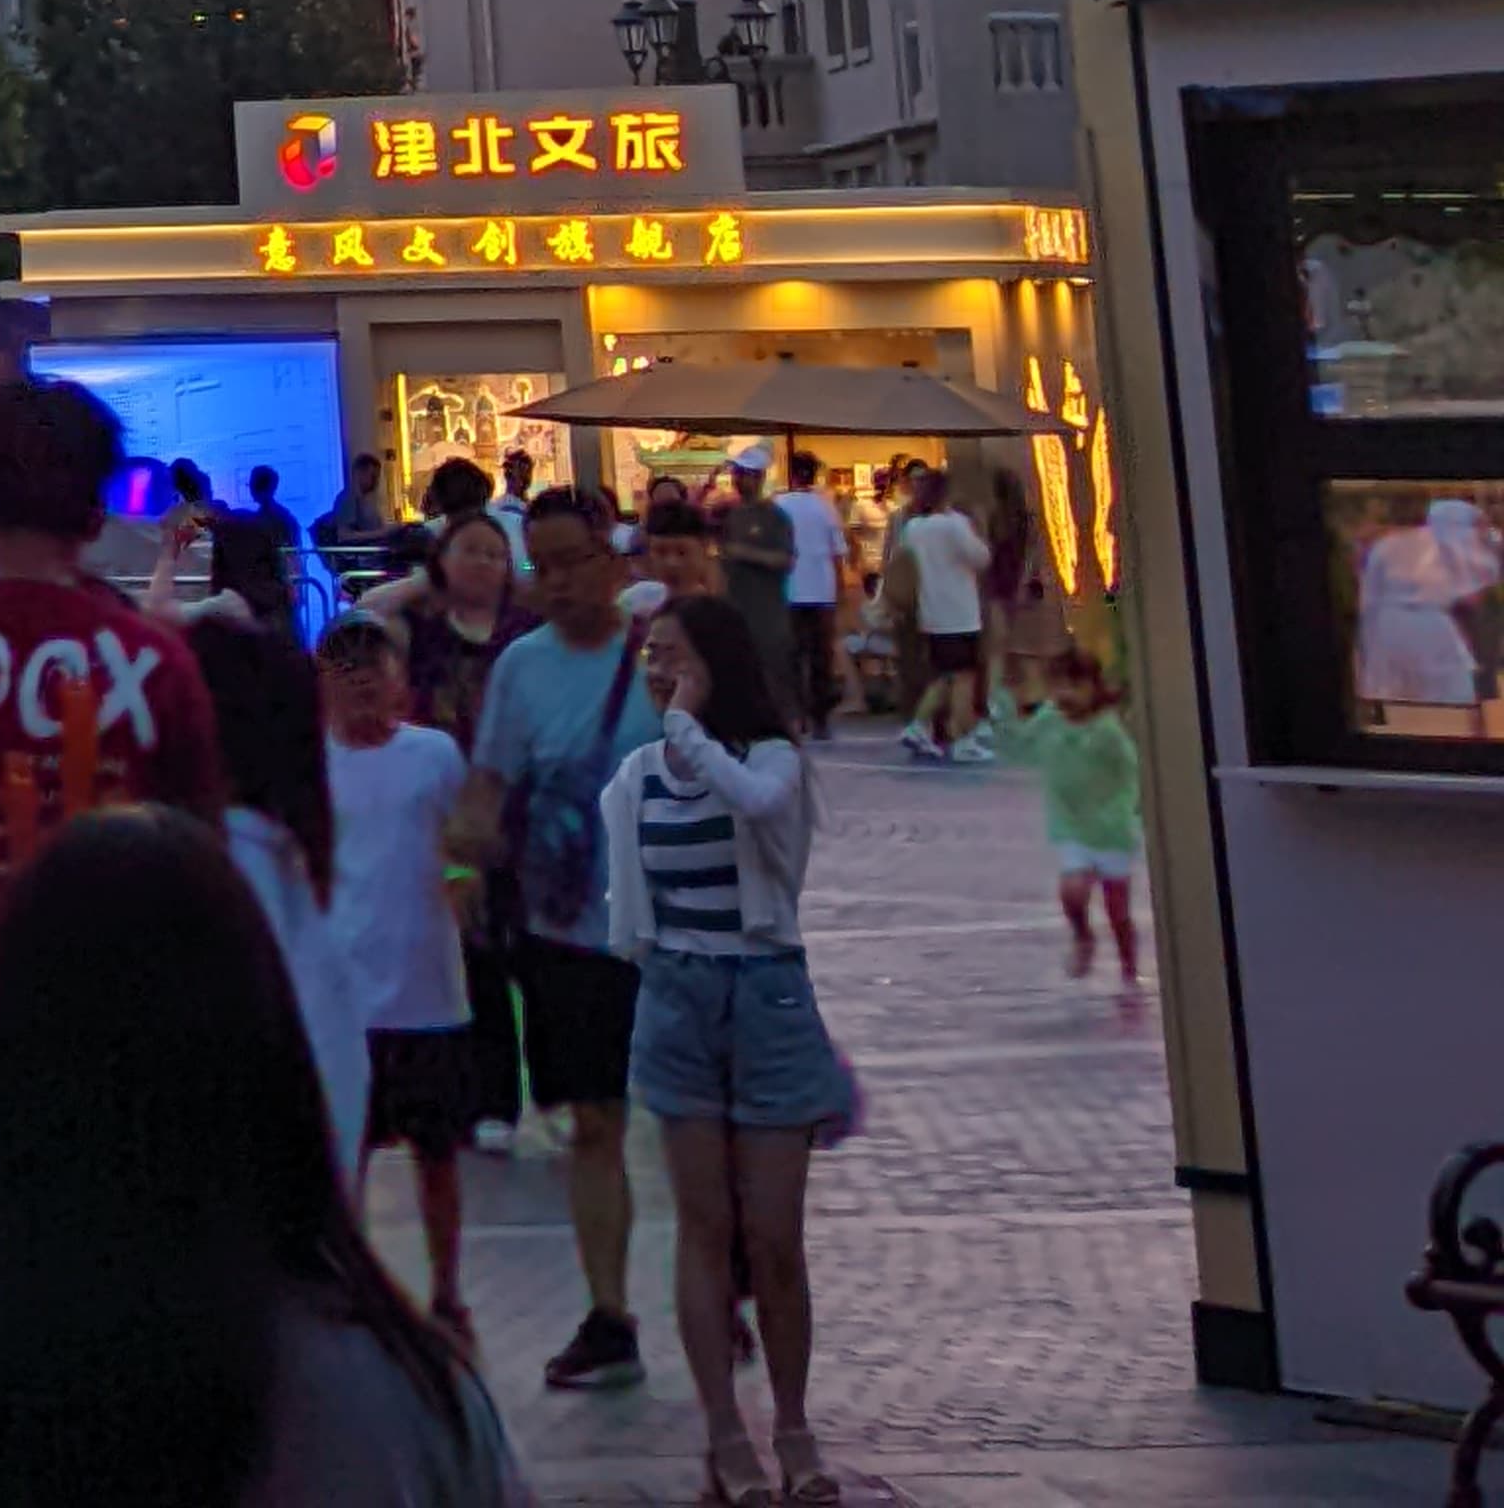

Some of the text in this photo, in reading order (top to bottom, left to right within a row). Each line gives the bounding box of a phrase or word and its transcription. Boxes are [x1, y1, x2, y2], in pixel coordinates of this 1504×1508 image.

[375, 112, 684, 177] 津北文旅
[260, 212, 745, 272] 意风文创旗舰店
